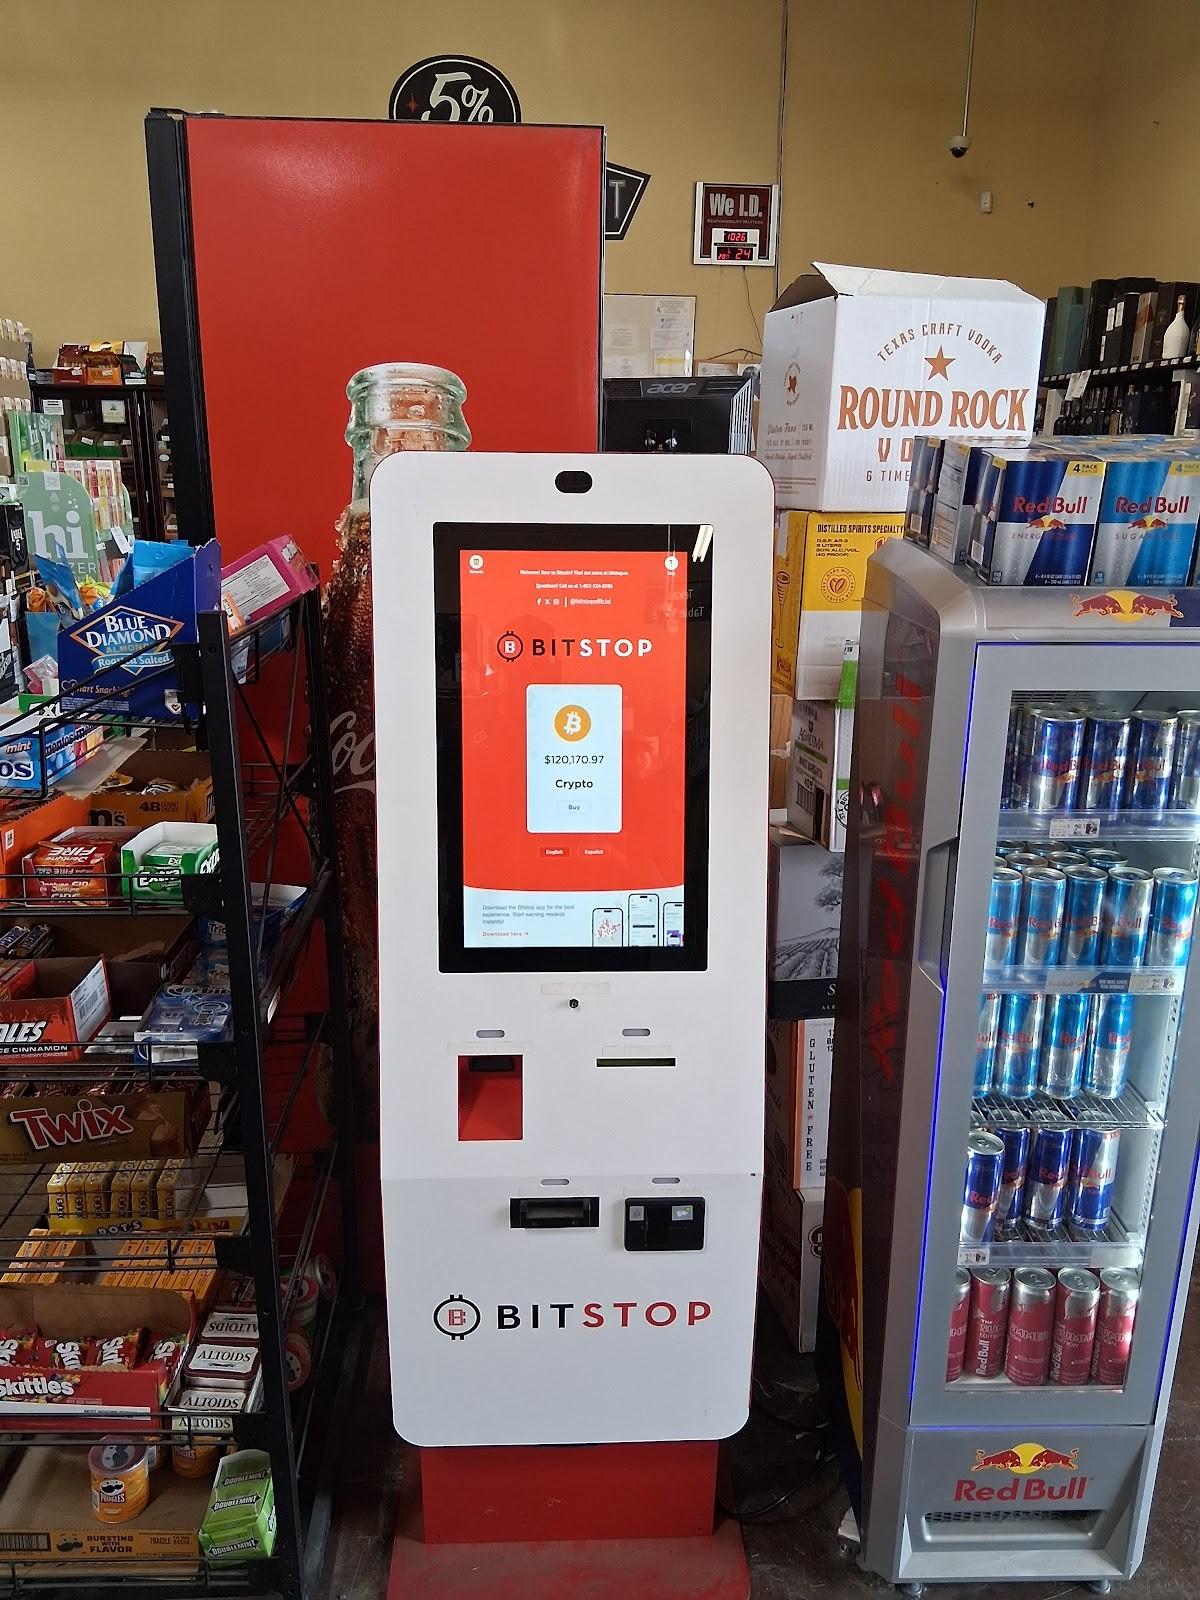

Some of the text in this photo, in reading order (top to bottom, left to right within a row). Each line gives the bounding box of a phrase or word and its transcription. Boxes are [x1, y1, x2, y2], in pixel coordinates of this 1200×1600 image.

[709, 193, 763, 217] We I.D.
[877, 322, 1003, 364] TEXAS CRAFT VODKA
[647, 382, 697, 394] acer
[836, 385, 1030, 432] ROUND ROCK
[1072, 463, 1080, 473] 4
[1012, 496, 1088, 514] Red Bull
[1115, 496, 1190, 513] Red Bull
[27, 510, 89, 559] hi
[817, 524, 904, 534] DISTILLED SPIRITS SPECIALTY
[104, 615, 148, 633] BLUE
[85, 623, 171, 648] DIAMOND
[532, 638, 653, 657] BITSTOP
[139, 653, 170, 665] Salted
[6, 741, 32, 754] mint
[544, 754, 605, 765] $120,170.97
[555, 779, 594, 790] Crypto
[139, 801, 160, 812] 48
[48, 847, 97, 856] FIRE
[12, 1045, 68, 1053] CINNAMON
[805, 1038, 816, 1172] GLUTEN FREE
[497, 1301, 712, 1330] BITSTOP
[197, 1350, 252, 1362] ALTOIDS
[975, 1339, 990, 1376] Red Bull
[0, 1376, 74, 1396] Skittles
[184, 1397, 240, 1408] ALTOIDS
[223, 1471, 266, 1486] DOUBLEMINT
[954, 1476, 1087, 1501] Red Bull
[100, 1491, 125, 1503] PRINGLES
[213, 1494, 258, 1511] DOUBLEMINT
[211, 1539, 256, 1555] DOUBLEMINT
